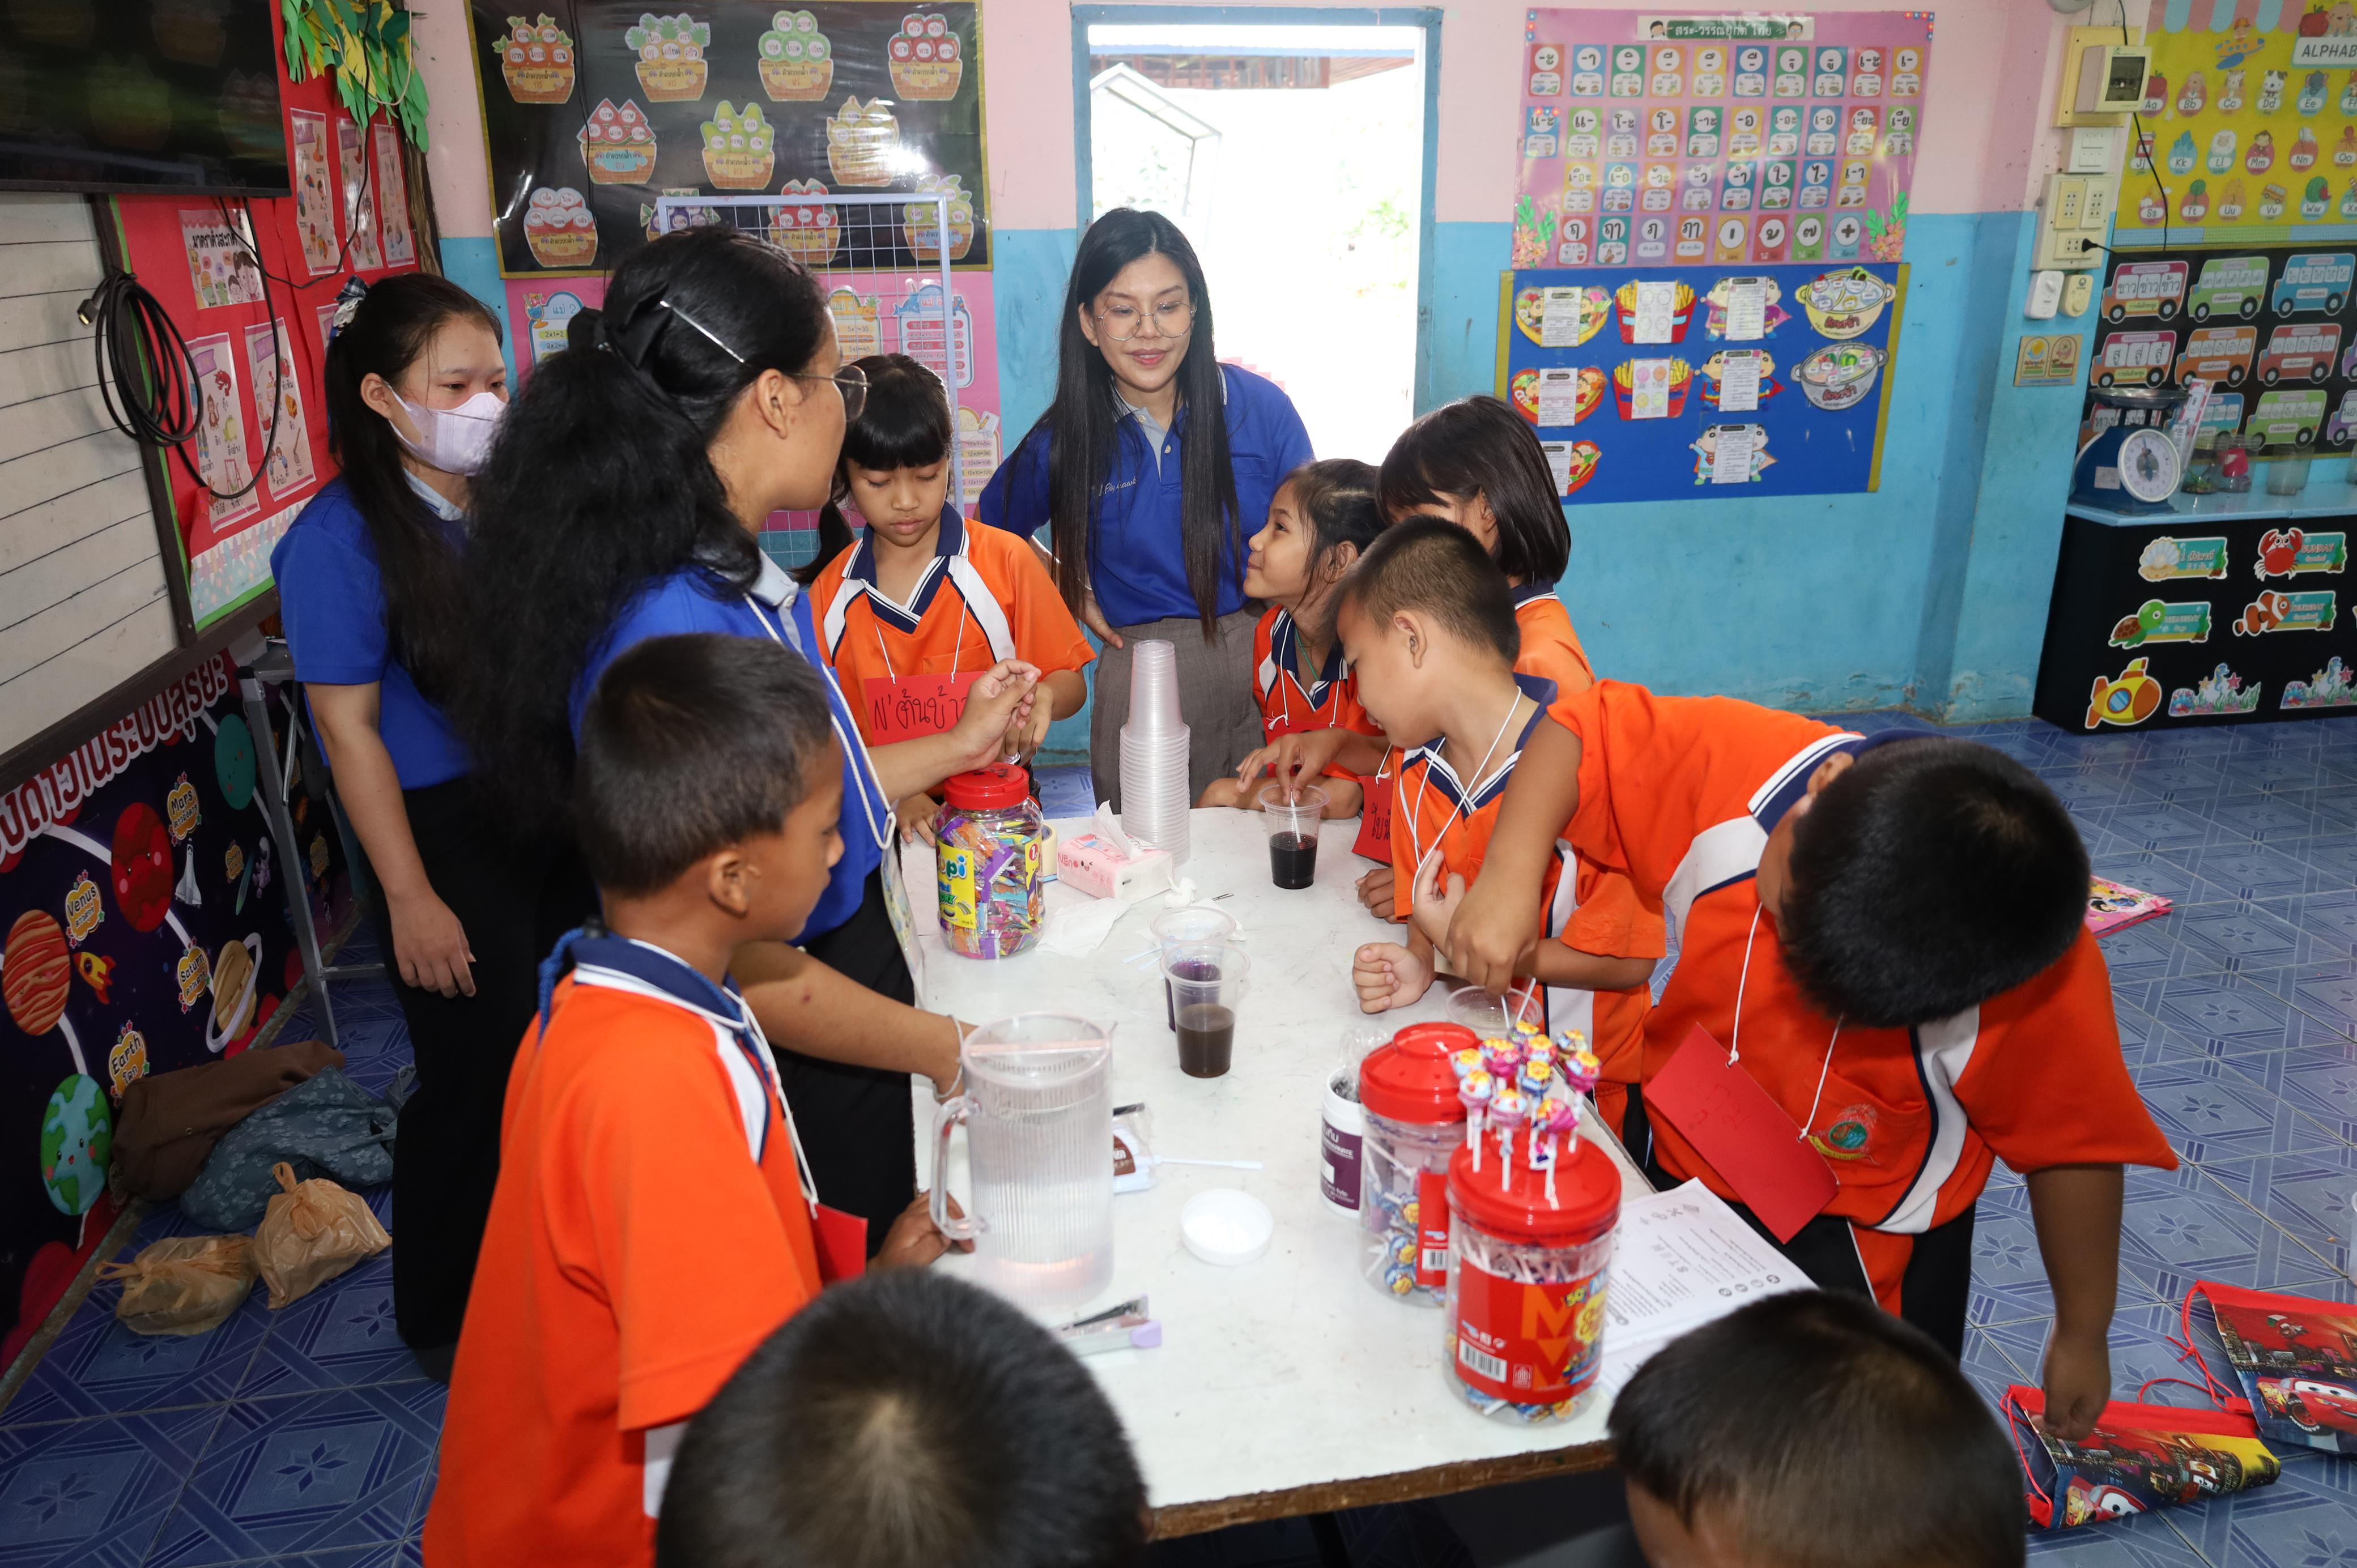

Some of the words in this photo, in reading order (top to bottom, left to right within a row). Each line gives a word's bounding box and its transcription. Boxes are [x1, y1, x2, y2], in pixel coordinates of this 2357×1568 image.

[1752, 24, 1772, 36] ไทย
[2301, 45, 2357, 58] ALPHAB
[2145, 98, 2157, 109] Aa
[2184, 97, 2196, 109] Bb
[2223, 99, 2236, 108] Cc
[2262, 97, 2276, 108] Dd
[2304, 99, 2316, 108] Ee
[2175, 157, 2186, 167] Kk
[2215, 157, 2224, 167] Ll
[2250, 158, 2266, 167] Mm
[2296, 156, 2308, 164] Nn
[2339, 154, 2351, 162] Oo
[2135, 159, 2146, 169] Jj
[2146, 208, 2157, 218] Ss
[2188, 207, 2198, 215] Tt
[2224, 206, 2236, 215] Uu
[2266, 206, 2277, 214] Vv
[2305, 204, 2321, 213] Ww
[192, 229, 239, 249] มาตราตัวสะกด
[2117, 283, 2137, 295] ขาว
[2140, 277, 2159, 293] ข่าว
[2162, 275, 2180, 292] ข้าว
[922, 296, 934, 306] แม่
[552, 303, 565, 314] แม่
[569, 304, 576, 314] 2
[2301, 544, 2335, 555] SUNDAY
[874, 685, 968, 731] N'ต้นข้า
[0, 653, 228, 850] งดาวในระบบสุรยะ
[171, 790, 193, 816] Mars
[67, 885, 97, 917] Venus
[180, 952, 205, 983] Saturn
[111, 1034, 142, 1075] Earth
[122, 1064, 138, 1085] โลก
